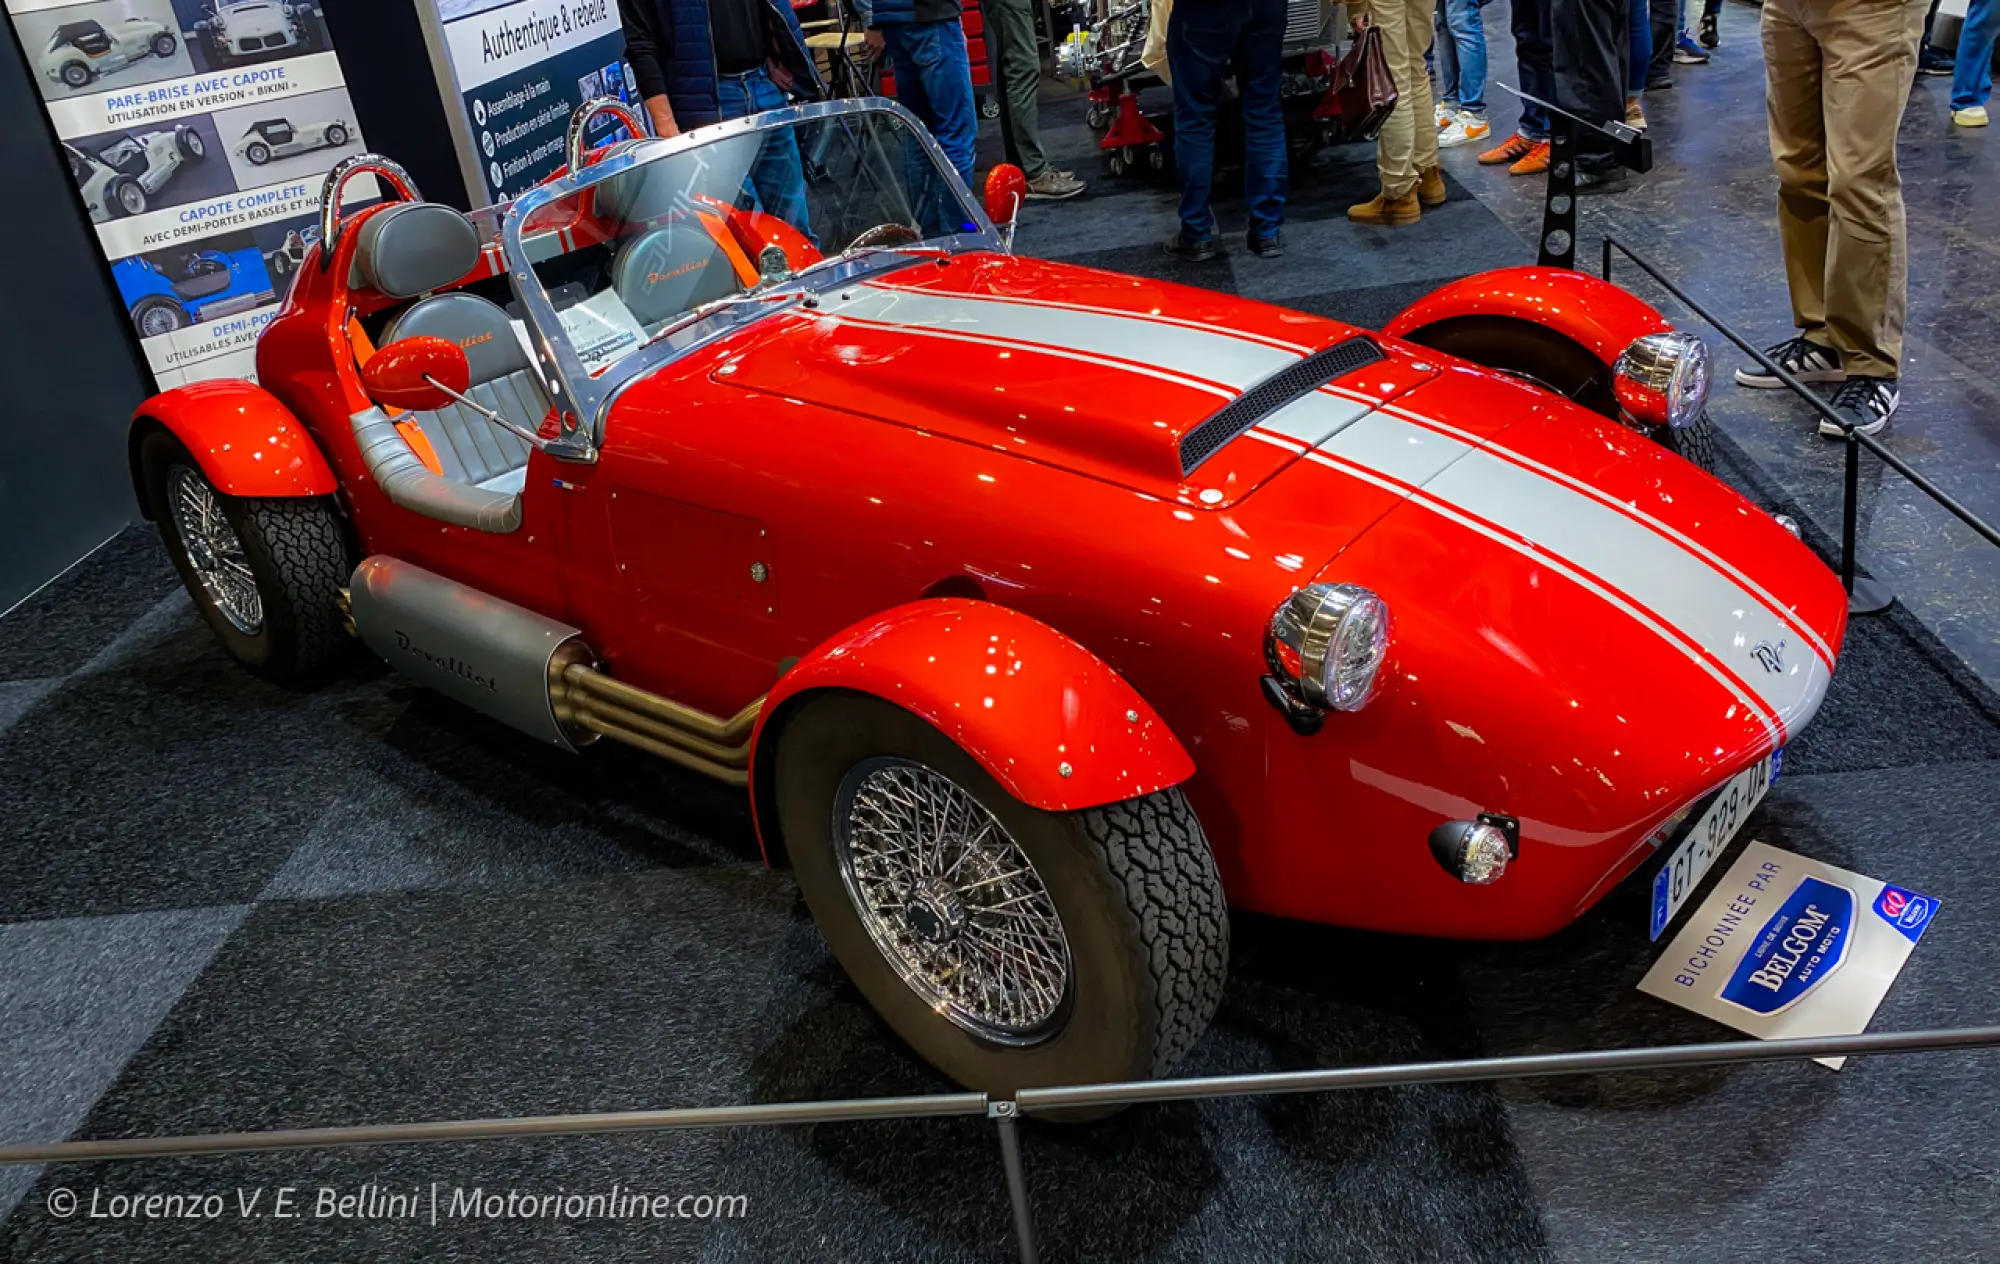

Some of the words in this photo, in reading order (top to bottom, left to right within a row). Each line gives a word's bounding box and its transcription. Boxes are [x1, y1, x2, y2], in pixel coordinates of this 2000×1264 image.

[482, 11, 561, 63] Authentique
[560, 4, 573, 33] &
[572, 0, 607, 30] rebelle
[107, 84, 190, 110] PARE-BRISE
[194, 77, 229, 94] AVEC
[232, 66, 286, 87] CAPOTE
[107, 102, 177, 124] UTILISATION
[180, 99, 195, 110] EN
[198, 90, 245, 107] VERSION
[257, 81, 290, 96] BIKINI
[487, 91, 525, 118] Assemblage
[535, 78, 551, 95] main
[494, 122, 530, 148] Production
[529, 118, 538, 131] en
[536, 109, 552, 127] série
[550, 98, 570, 120] limitée
[502, 156, 528, 178] Finition
[531, 145, 548, 162] votre
[546, 136, 564, 153] image
[143, 230, 171, 246] AVEC
[173, 213, 246, 238] DEMI-PORTES
[248, 202, 287, 220] BASSES
[290, 199, 303, 211] ET
[179, 201, 234, 223] CAPOTE
[238, 184, 306, 210] COMPLÈTE
[165, 338, 232, 363] UTILISABLES
[1675, 893, 1756, 987] BICHONNÉE
[1748, 862, 1782, 892] PAR
[1748, 905, 1831, 993] BELGOM
[1798, 955, 1822, 983] AUTO
[1817, 926, 1841, 954] MOTO
